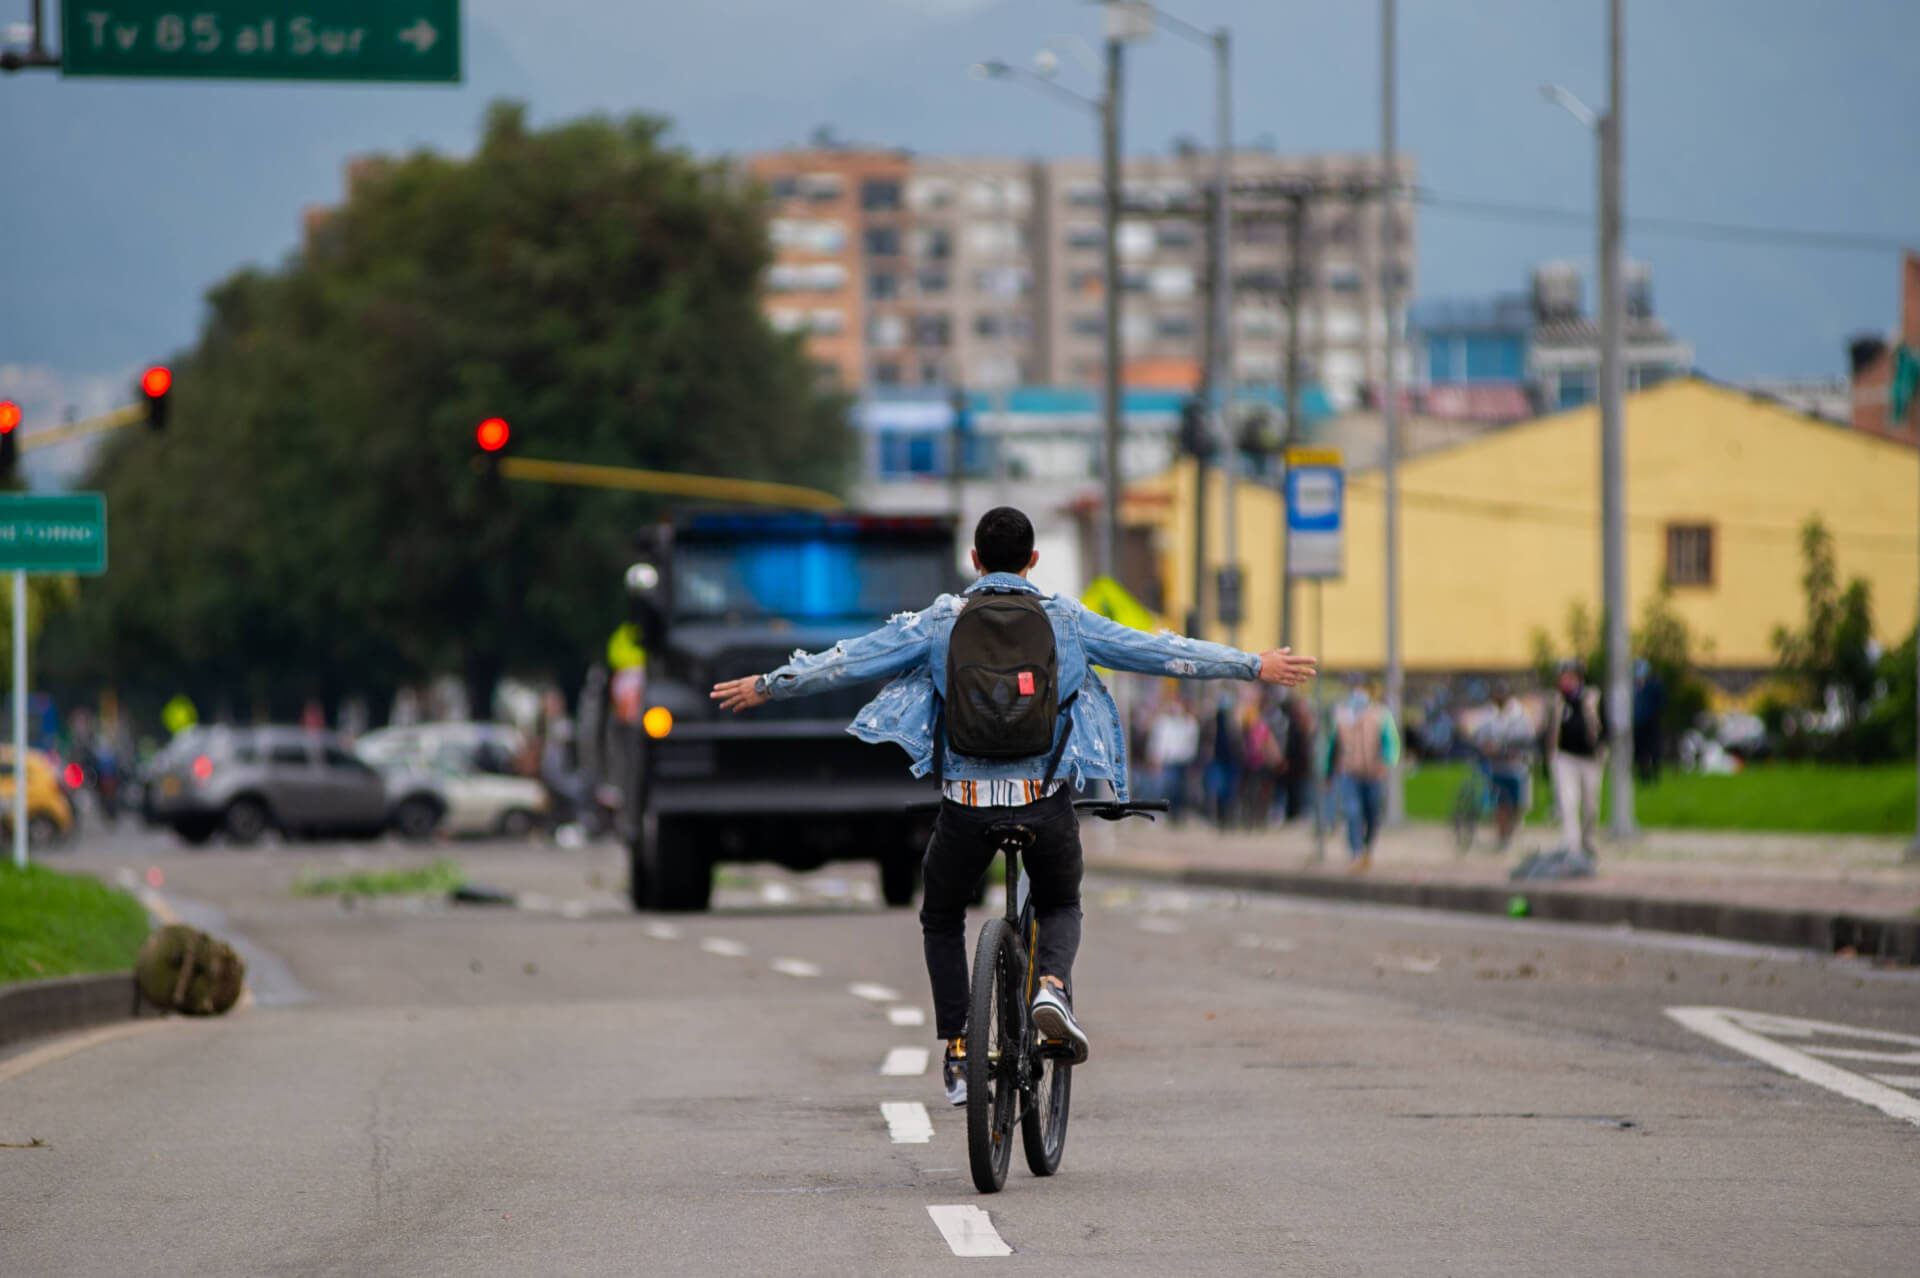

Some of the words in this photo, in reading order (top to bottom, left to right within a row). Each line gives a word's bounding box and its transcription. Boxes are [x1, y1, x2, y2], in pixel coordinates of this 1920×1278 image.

[86, 12, 139, 50] Tv
[235, 19, 275, 53] al
[289, 16, 365, 55] Sur
